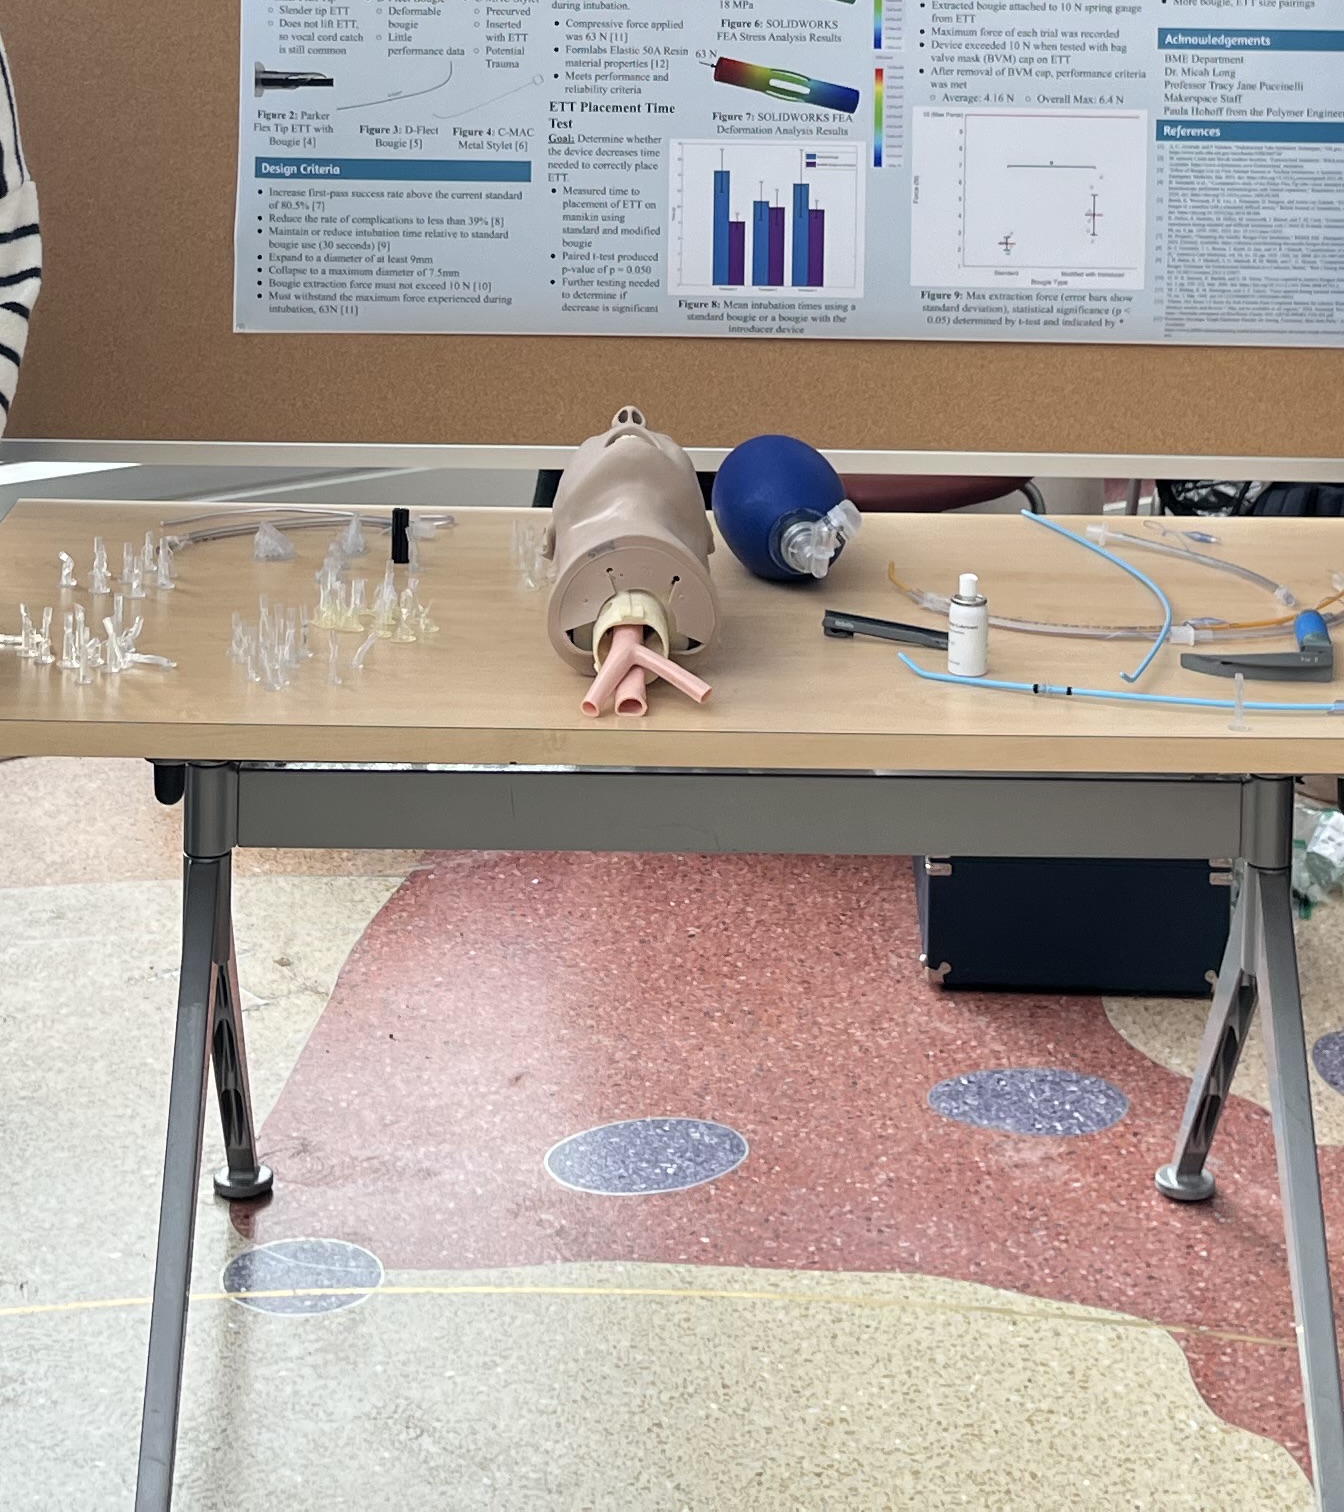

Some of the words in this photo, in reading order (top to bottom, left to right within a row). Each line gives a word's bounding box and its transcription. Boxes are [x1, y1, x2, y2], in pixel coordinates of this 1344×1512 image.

[720, 0, 730, 9] 18
[732, 0, 754, 9] MPa
[565, 18, 623, 29] Compressive
[626, 19, 649, 29] force
[650, 19, 684, 32] applied
[720, 18, 752, 29] Figure
[754, 19, 763, 28] 6:
[766, 19, 838, 29] SOLIDWORKS
[716, 31, 737, 41] FEA
[739, 32, 766, 41] Stress
[768, 32, 806, 44] Analysis
[808, 32, 842, 43] Results
[1164, 33, 1271, 46] Acknowledgements
[695, 48, 706, 58] 63
[708, 49, 719, 58] N
[1181, 67, 1210, 77] Micah
[1212, 67, 1236, 79] Long
[1164, 80, 1206, 90] Professor
[1210, 80, 1234, 92] Tracy
[1236, 81, 1257, 91] Jane
[1259, 81, 1304, 91] Puccinelli
[1163, 93, 1218, 104] Makerspace
[1220, 94, 1242, 103] Staff
[549, 101, 574, 112] ETT
[580, 101, 641, 113] Placement
[647, 102, 675, 113] Time
[712, 111, 743, 122] Figure
[745, 112, 754, 121] 7:
[757, 112, 830, 122] SOLIDWORKS
[832, 112, 853, 123] FEA
[551, 118, 572, 129] Test
[716, 124, 773, 135] Deformation
[774, 125, 813, 137] Analysis
[815, 126, 849, 136] Results
[1163, 124, 1221, 137] References
[261, 162, 297, 176] Design
[299, 163, 340, 175] Criteria
[268, 252, 303, 263] Expand
[304, 254, 314, 262] to
[323, 253, 362, 263] diameter
[364, 253, 374, 263] of
[376, 255, 385, 263] at
[387, 254, 408, 264] least
[409, 254, 433, 264] 9mm
